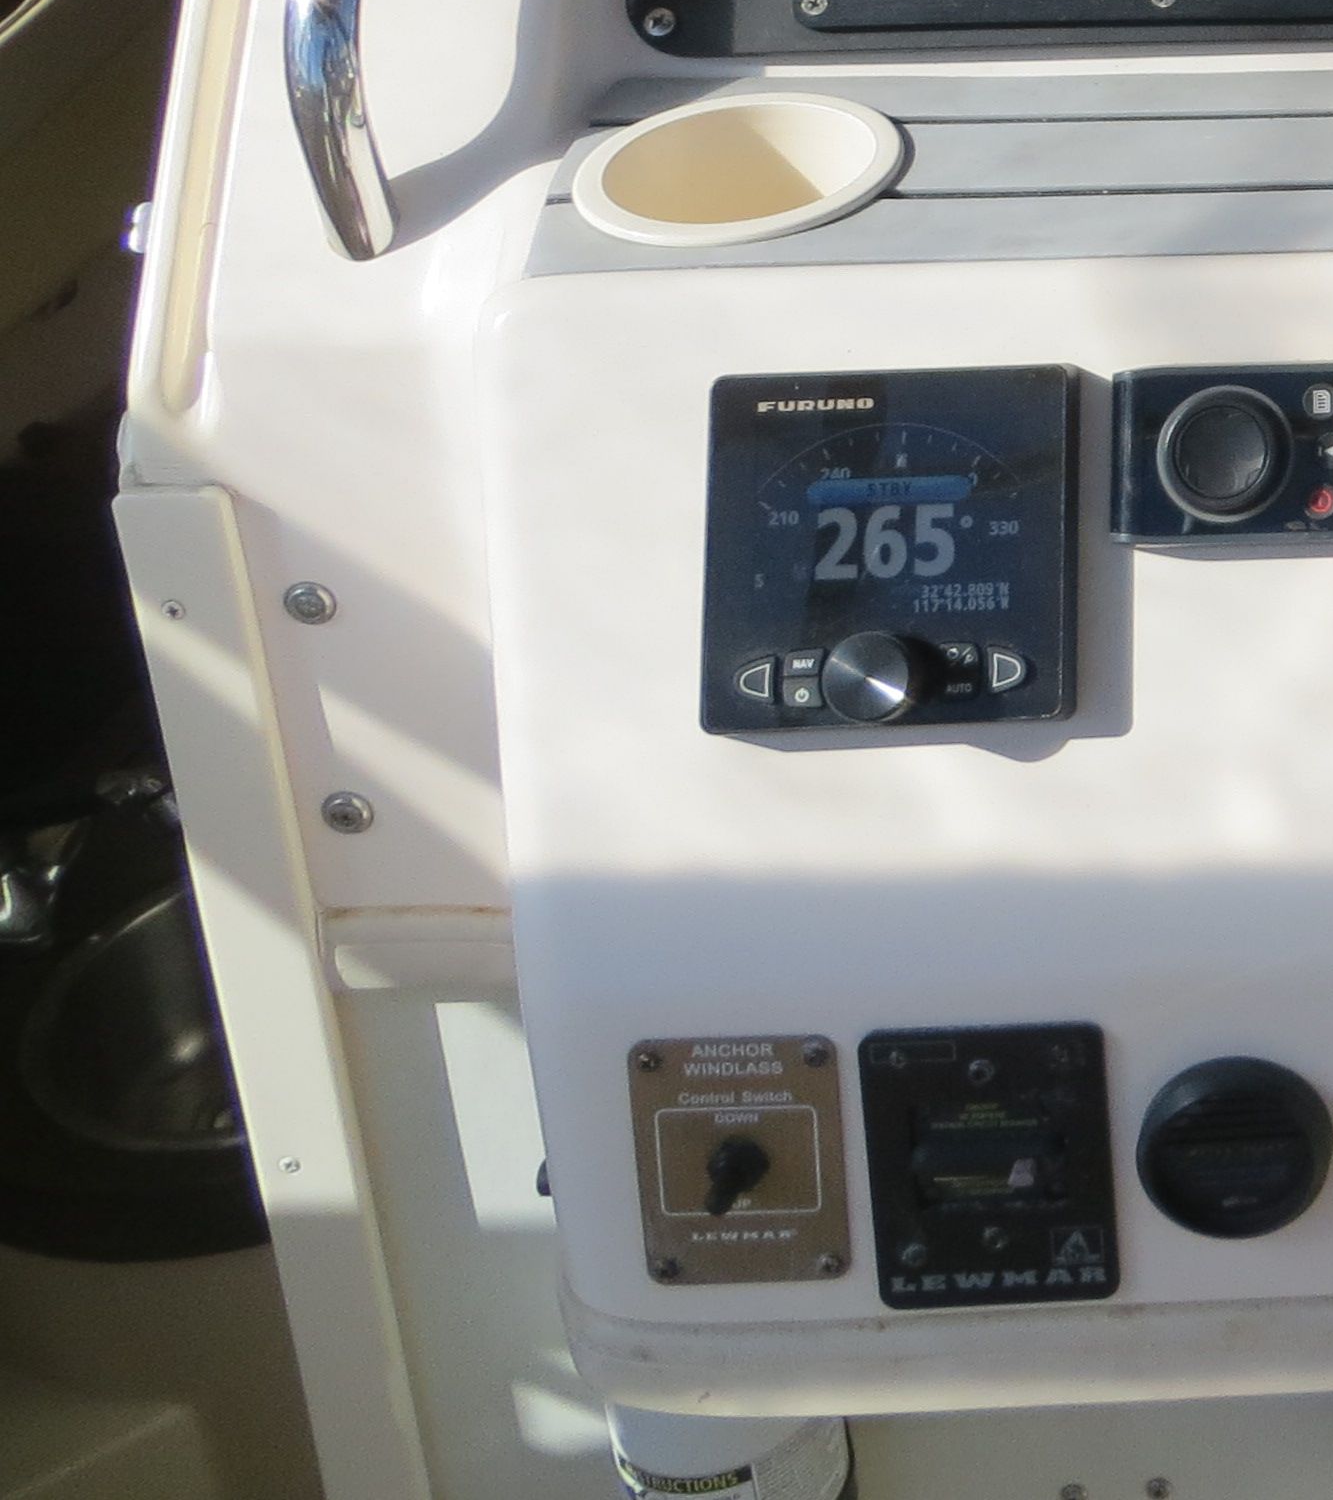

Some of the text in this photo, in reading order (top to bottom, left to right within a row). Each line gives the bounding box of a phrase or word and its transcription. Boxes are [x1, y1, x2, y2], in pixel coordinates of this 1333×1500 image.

[757, 397, 875, 413] FURUNO
[768, 508, 800, 526] 210
[988, 519, 1019, 536] 330
[792, 657, 816, 670] NAV
[946, 681, 975, 695] AUTO
[691, 1043, 774, 1058] ANCHOR
[683, 1060, 785, 1077] WINDLASS
[677, 1090, 793, 1106] Control Switch
[713, 1112, 759, 1125] DOWN
[691, 1228, 796, 1243] LEWMAR
[890, 1265, 1108, 1293] LEWMAR
